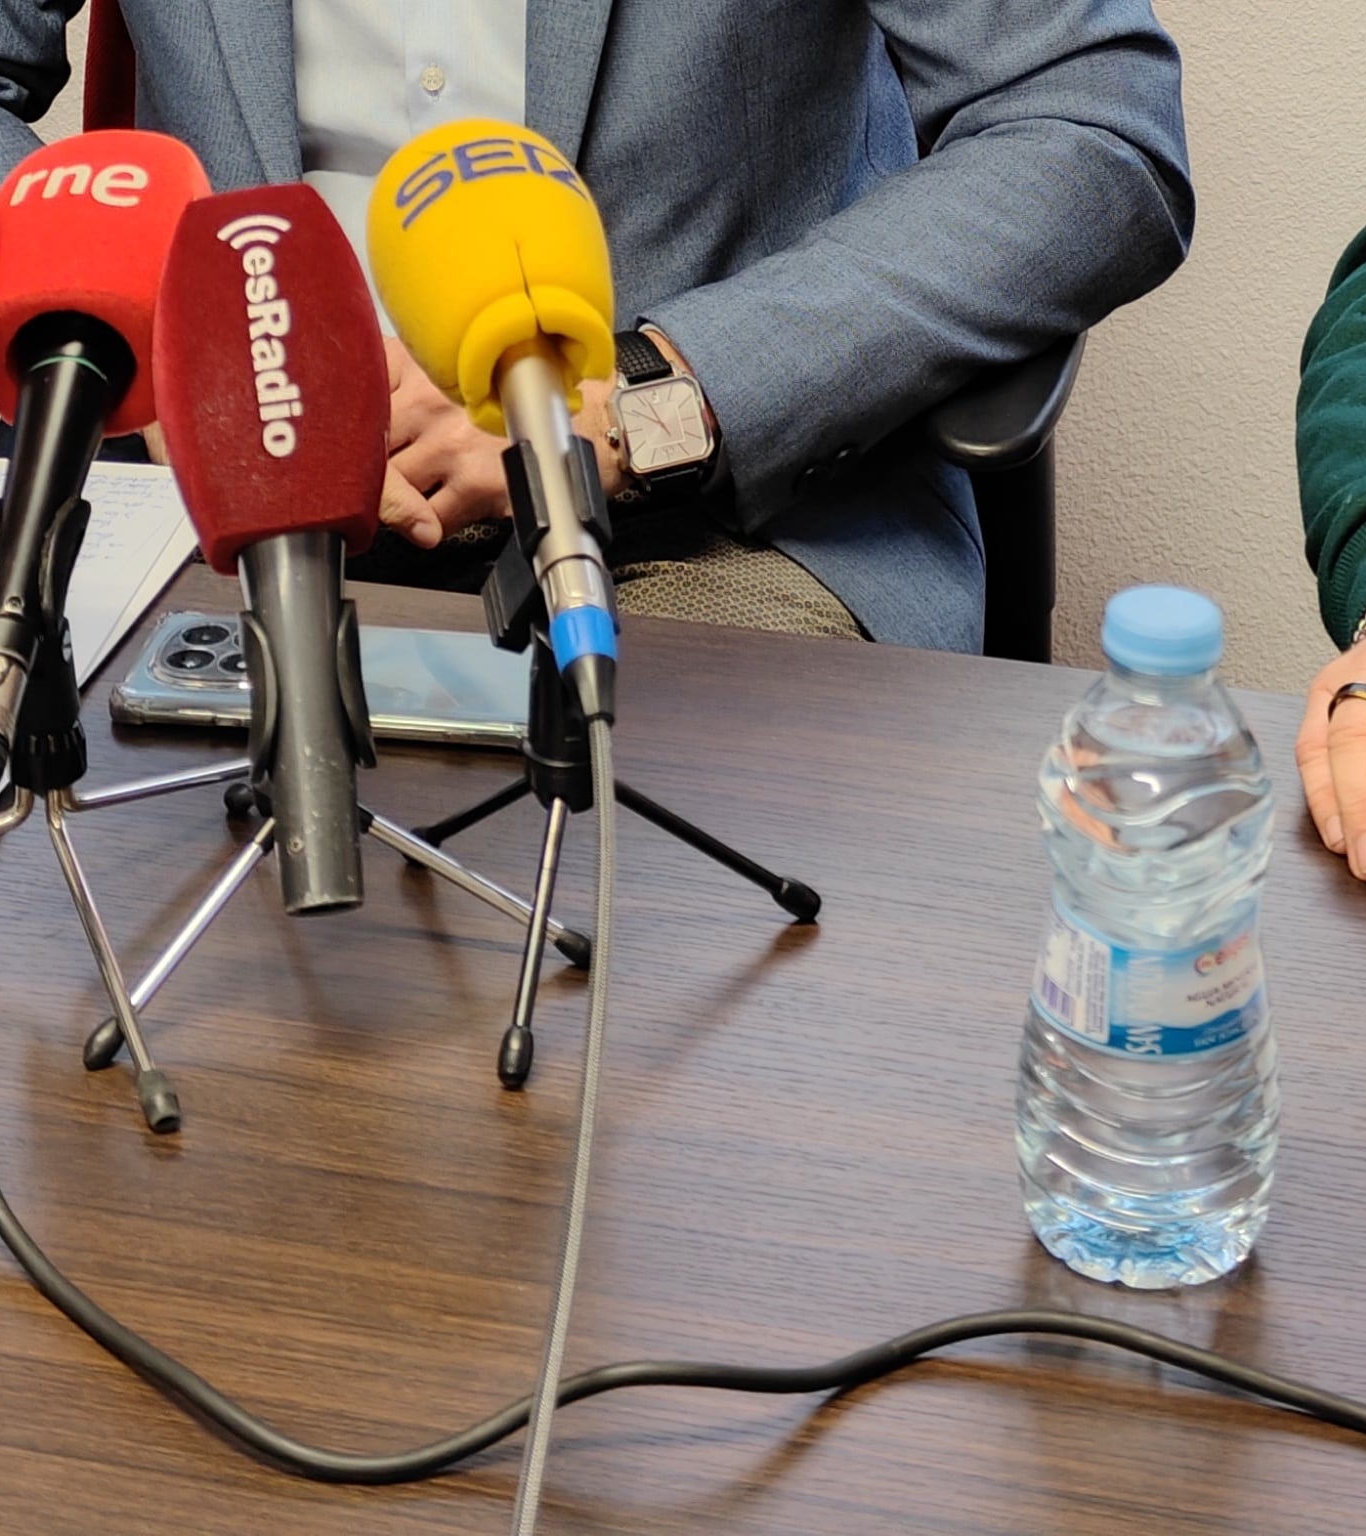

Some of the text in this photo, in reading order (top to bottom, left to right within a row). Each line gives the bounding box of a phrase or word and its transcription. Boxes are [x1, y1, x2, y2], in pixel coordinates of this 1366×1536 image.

[9, 163, 150, 208] rne
[394, 138, 589, 232] SER
[241, 245, 304, 458] esRadio
